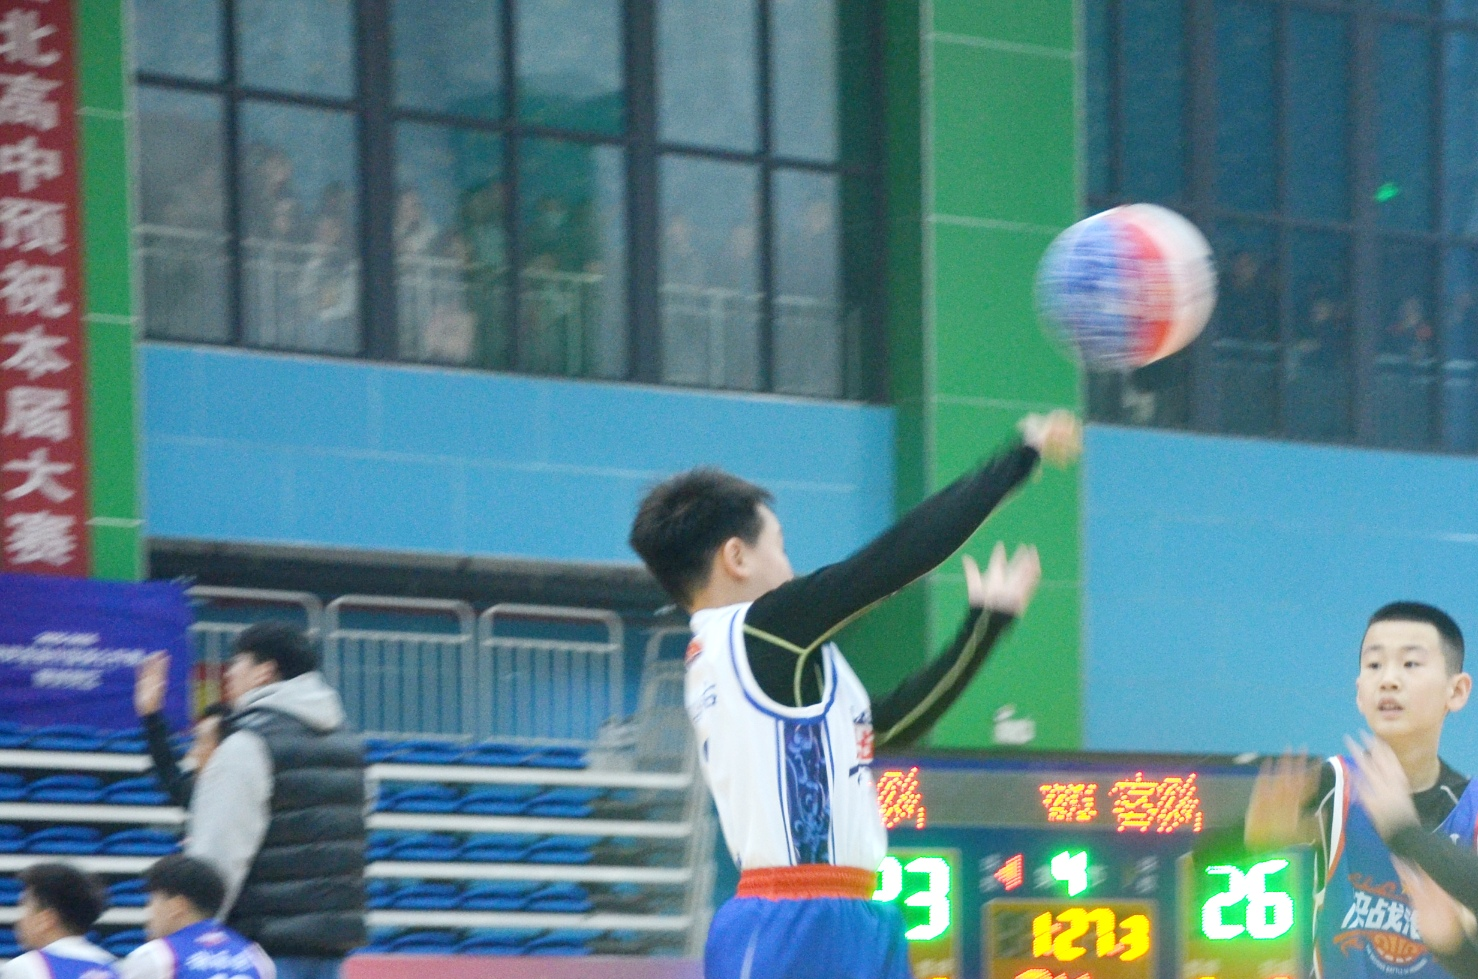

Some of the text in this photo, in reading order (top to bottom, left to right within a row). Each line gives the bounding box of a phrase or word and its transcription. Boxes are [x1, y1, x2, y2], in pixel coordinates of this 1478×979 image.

[1108, 771, 1203, 833] 客队
[1050, 850, 1087, 896] 4
[1201, 858, 1294, 940] 26
